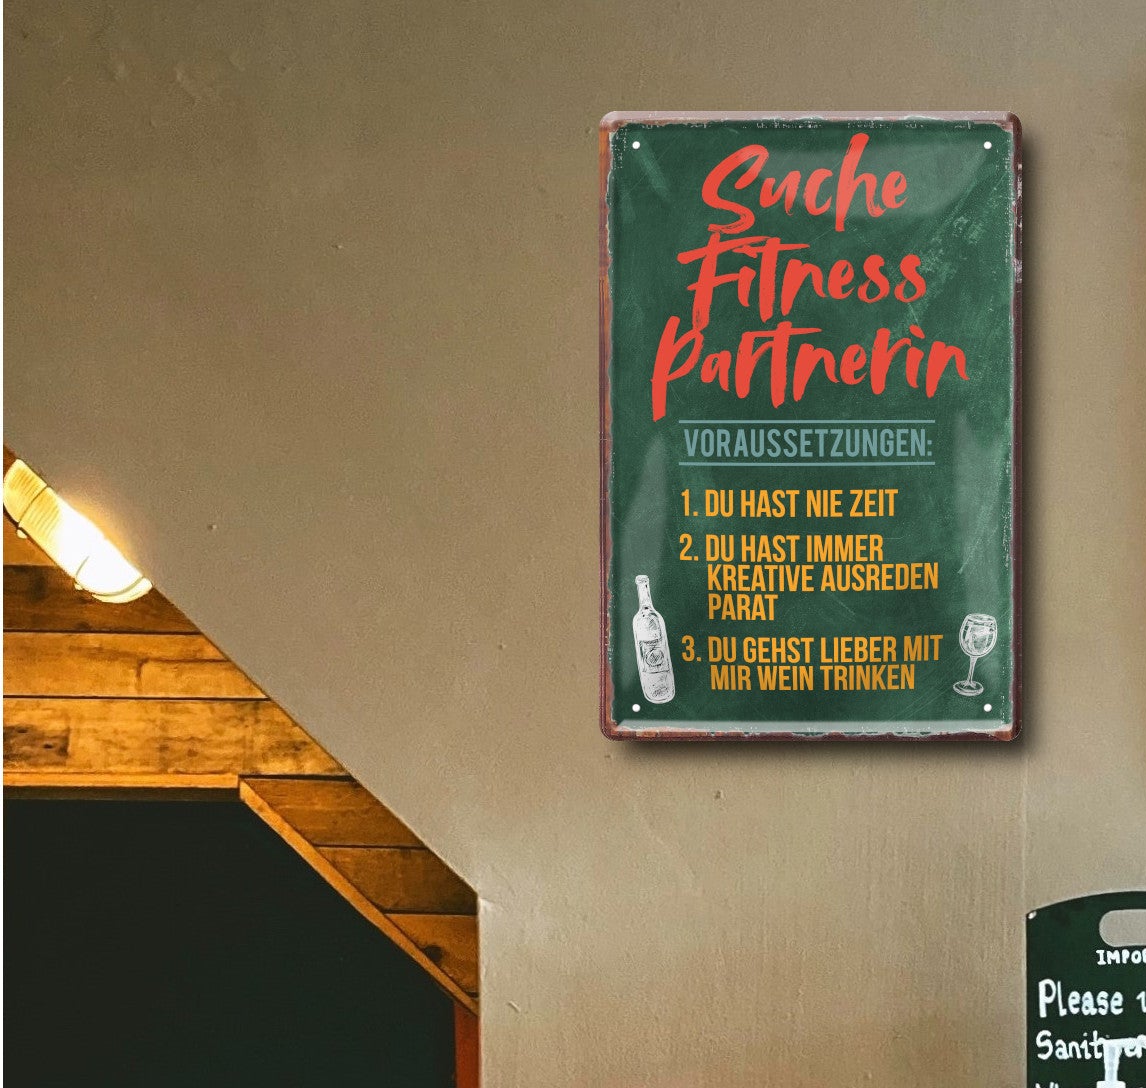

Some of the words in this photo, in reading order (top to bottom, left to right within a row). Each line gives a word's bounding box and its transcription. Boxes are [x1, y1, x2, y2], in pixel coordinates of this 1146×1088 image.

[702, 133, 908, 234] Suche
[677, 232, 927, 328] Fitness
[651, 316, 969, 422] Partnerin
[684, 428, 933, 458] VORAUSSETZUNGEN:
[681, 488, 699, 517] 1.
[705, 489, 734, 518] DU
[741, 490, 798, 518] HAST
[806, 489, 843, 518] NIE
[850, 488, 899, 517] ZEIT
[679, 533, 699, 561] 2.
[705, 535, 735, 562] DU
[742, 535, 800, 562] HAST
[806, 534, 883, 562] IMMER
[707, 564, 813, 592] KREATIVE
[820, 562, 939, 592] AUSREDEN
[708, 594, 778, 621] PARAT
[681, 635, 701, 662] 3.
[708, 637, 737, 663] DU
[743, 637, 814, 663] GEHST
[820, 636, 897, 663] LIEBER
[903, 635, 943, 661] MIT
[711, 665, 751, 690] MIR
[757, 665, 814, 690] WEIN
[820, 664, 915, 690] TRINKEN
[1038, 978, 1124, 1018] Please
